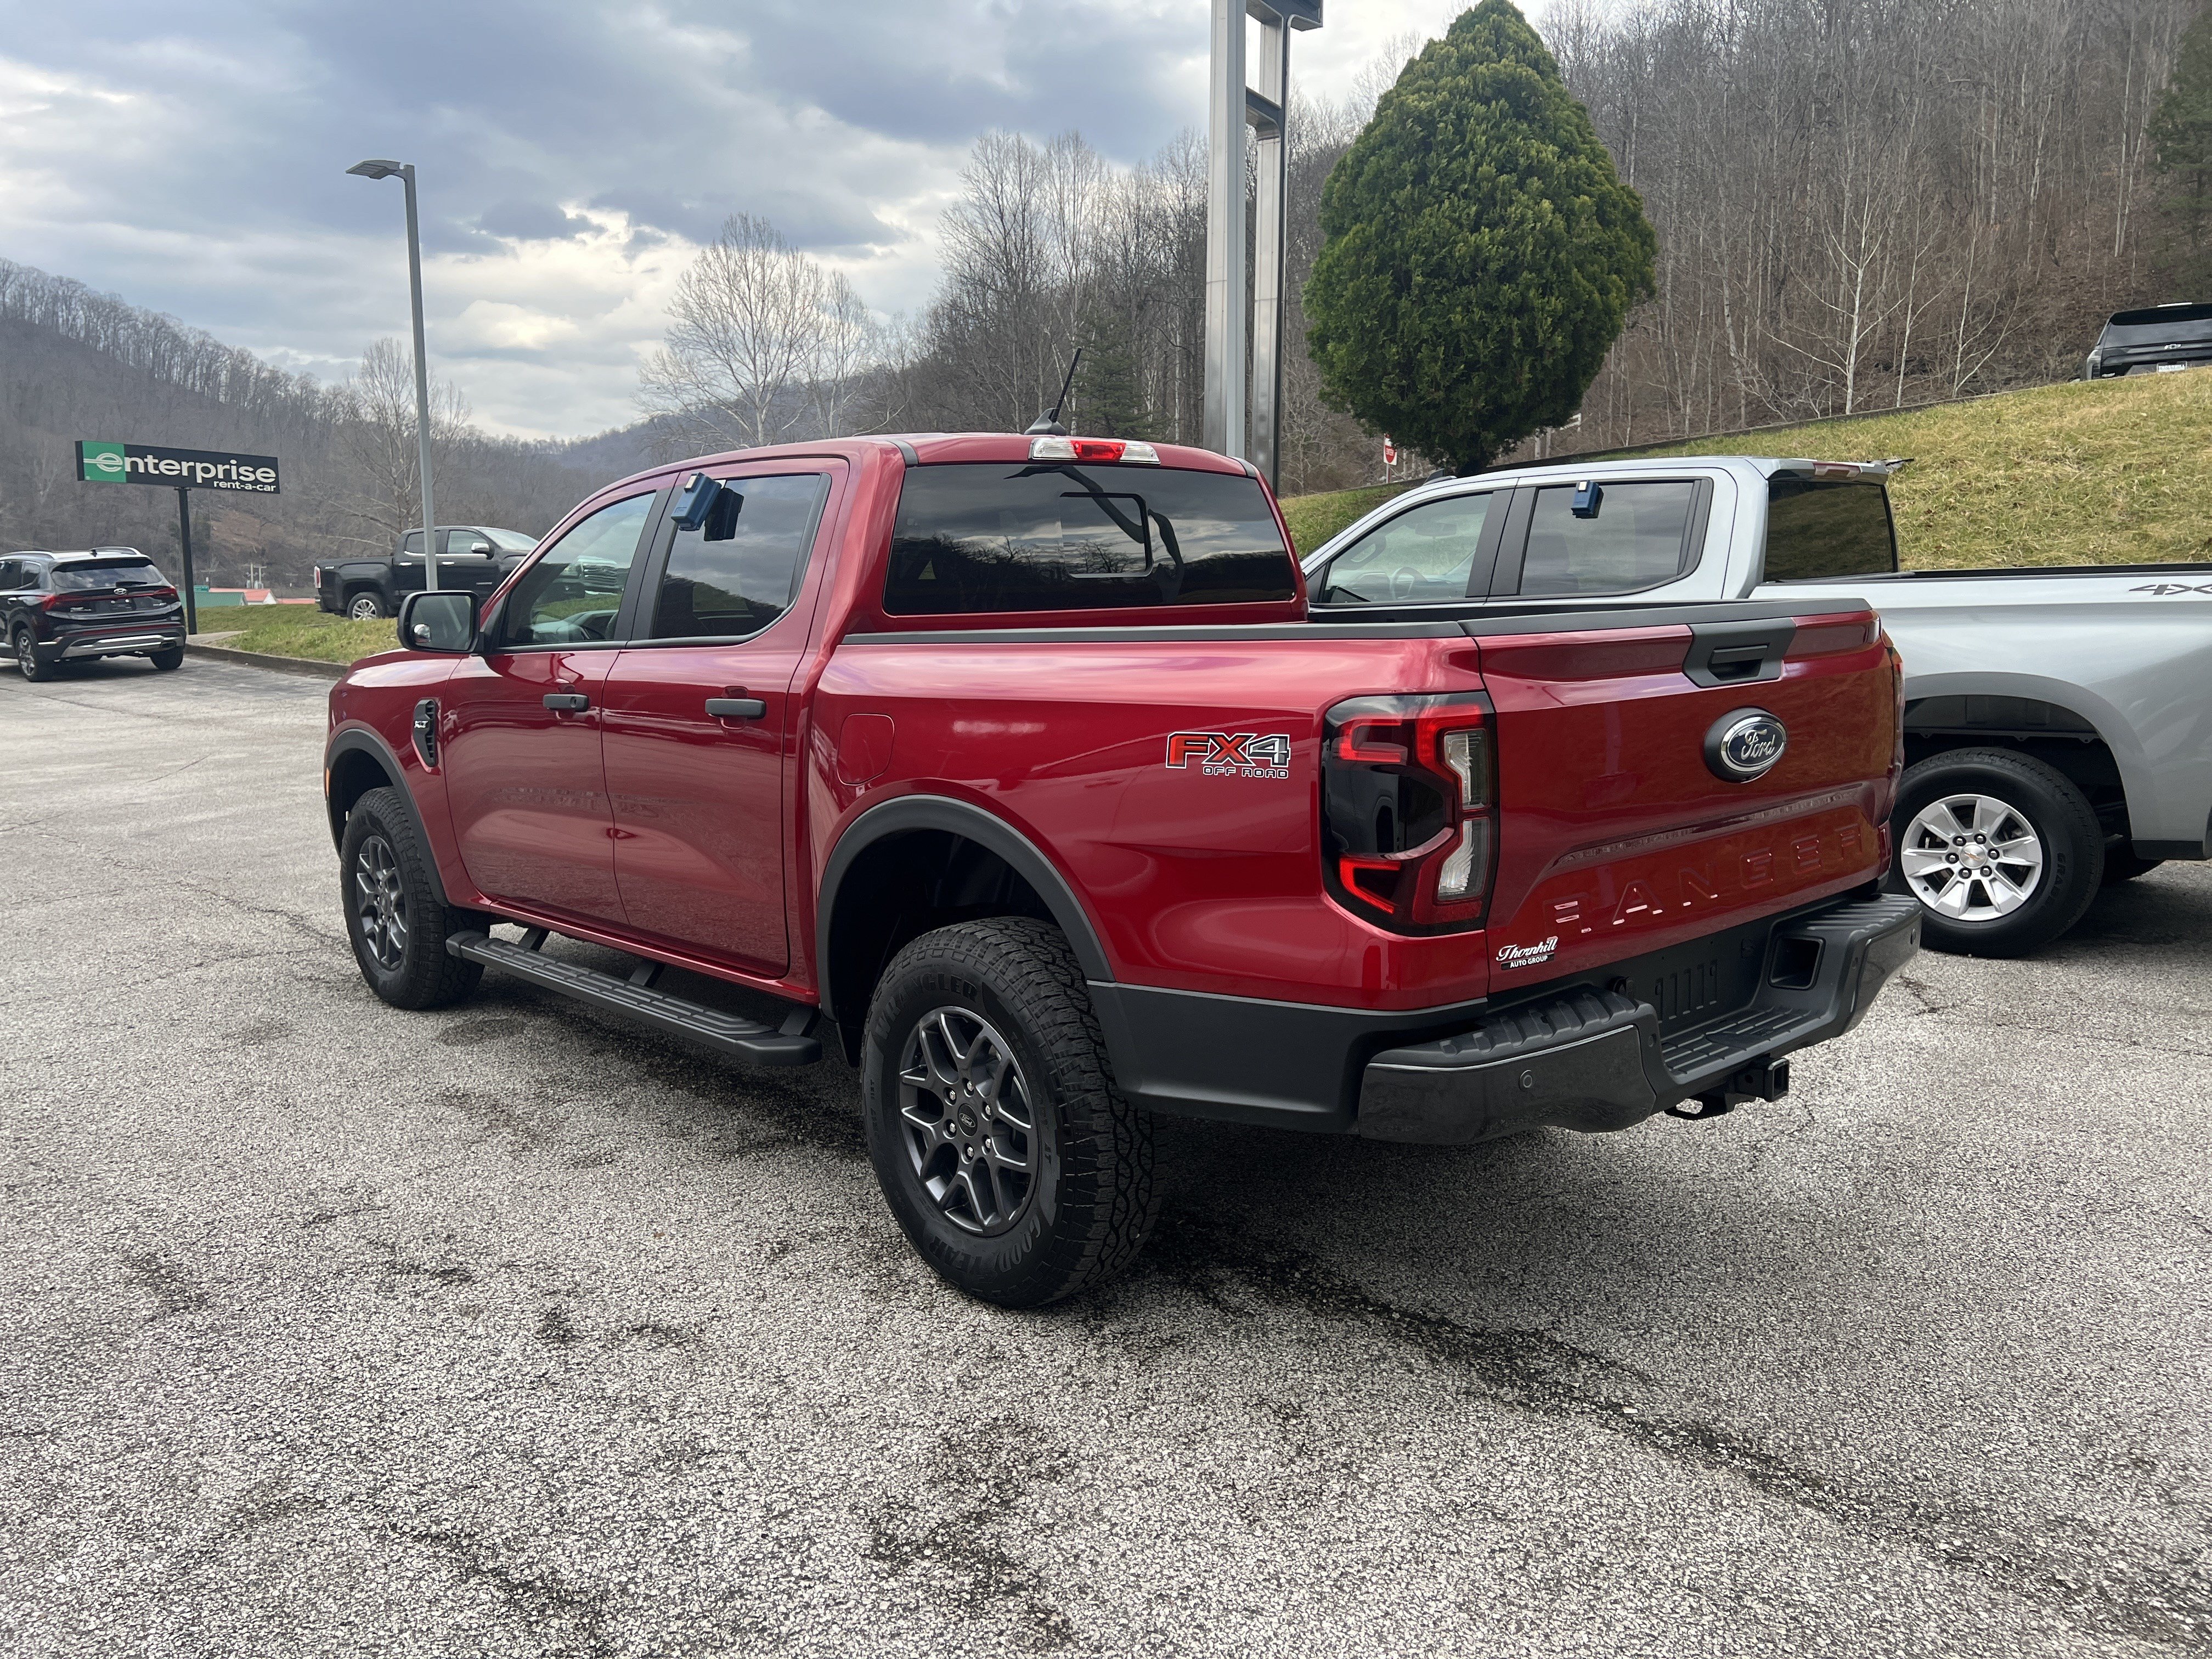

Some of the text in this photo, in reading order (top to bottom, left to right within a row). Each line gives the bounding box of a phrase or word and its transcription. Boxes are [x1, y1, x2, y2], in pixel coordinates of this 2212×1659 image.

[83, 452, 276, 484] enterprise
[213, 479, 276, 492] rent-a-car
[2129, 583, 2212, 595] 4X
[1165, 731, 1291, 769] FX4
[1741, 729, 1775, 760] Ford
[1202, 766, 1289, 780] OFF ROAD
[1543, 823, 1864, 940] RANGER
[1496, 938, 1559, 962] Thornhill
[1510, 955, 1548, 968] AUTO GROUP
[874, 972, 978, 1041] WRANGLER
